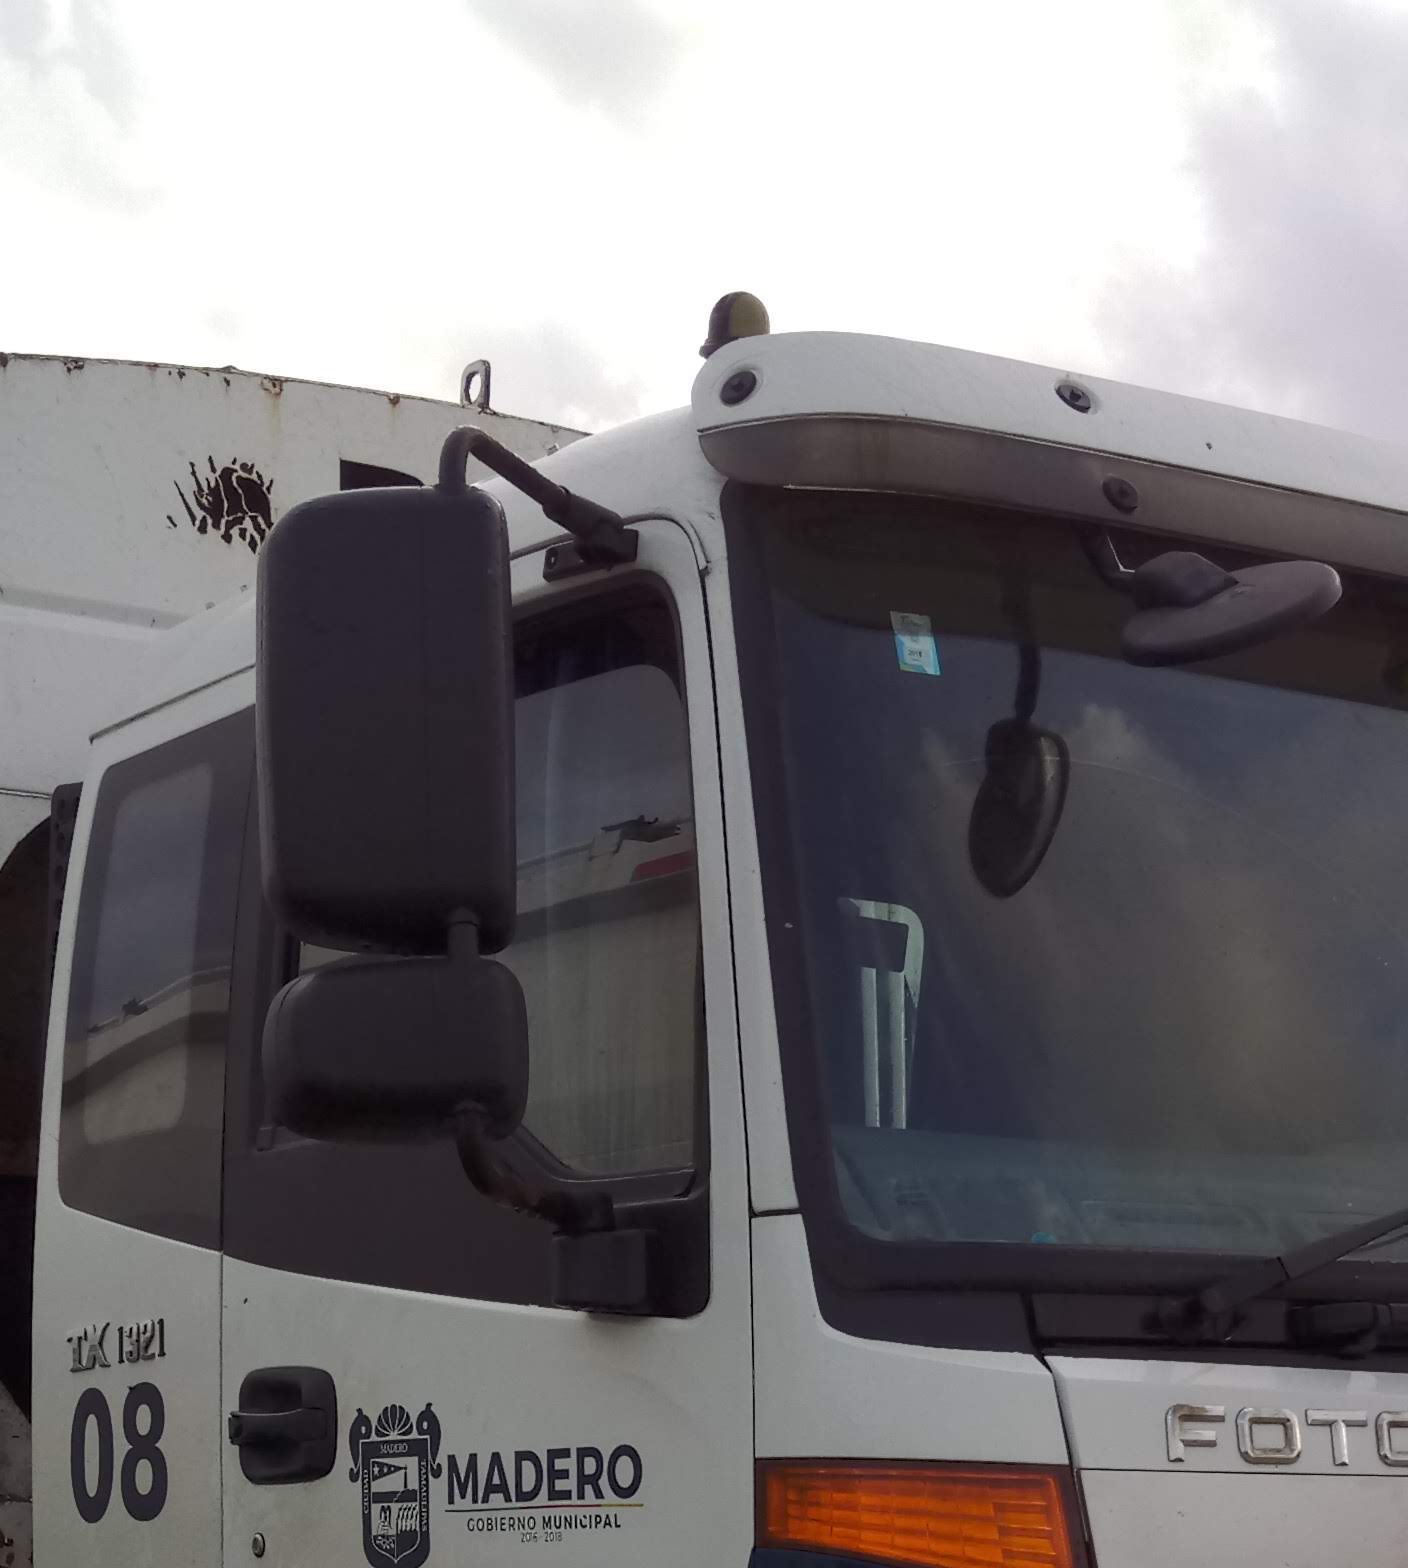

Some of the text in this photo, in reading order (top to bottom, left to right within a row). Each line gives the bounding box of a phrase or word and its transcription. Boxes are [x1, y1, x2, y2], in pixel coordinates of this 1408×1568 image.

[117, 1318, 167, 1364] 1321
[70, 1382, 168, 1523] 08
[447, 1444, 642, 1505] MADERO
[467, 1513, 621, 1532] GOBIERNO MUNICIPAL
